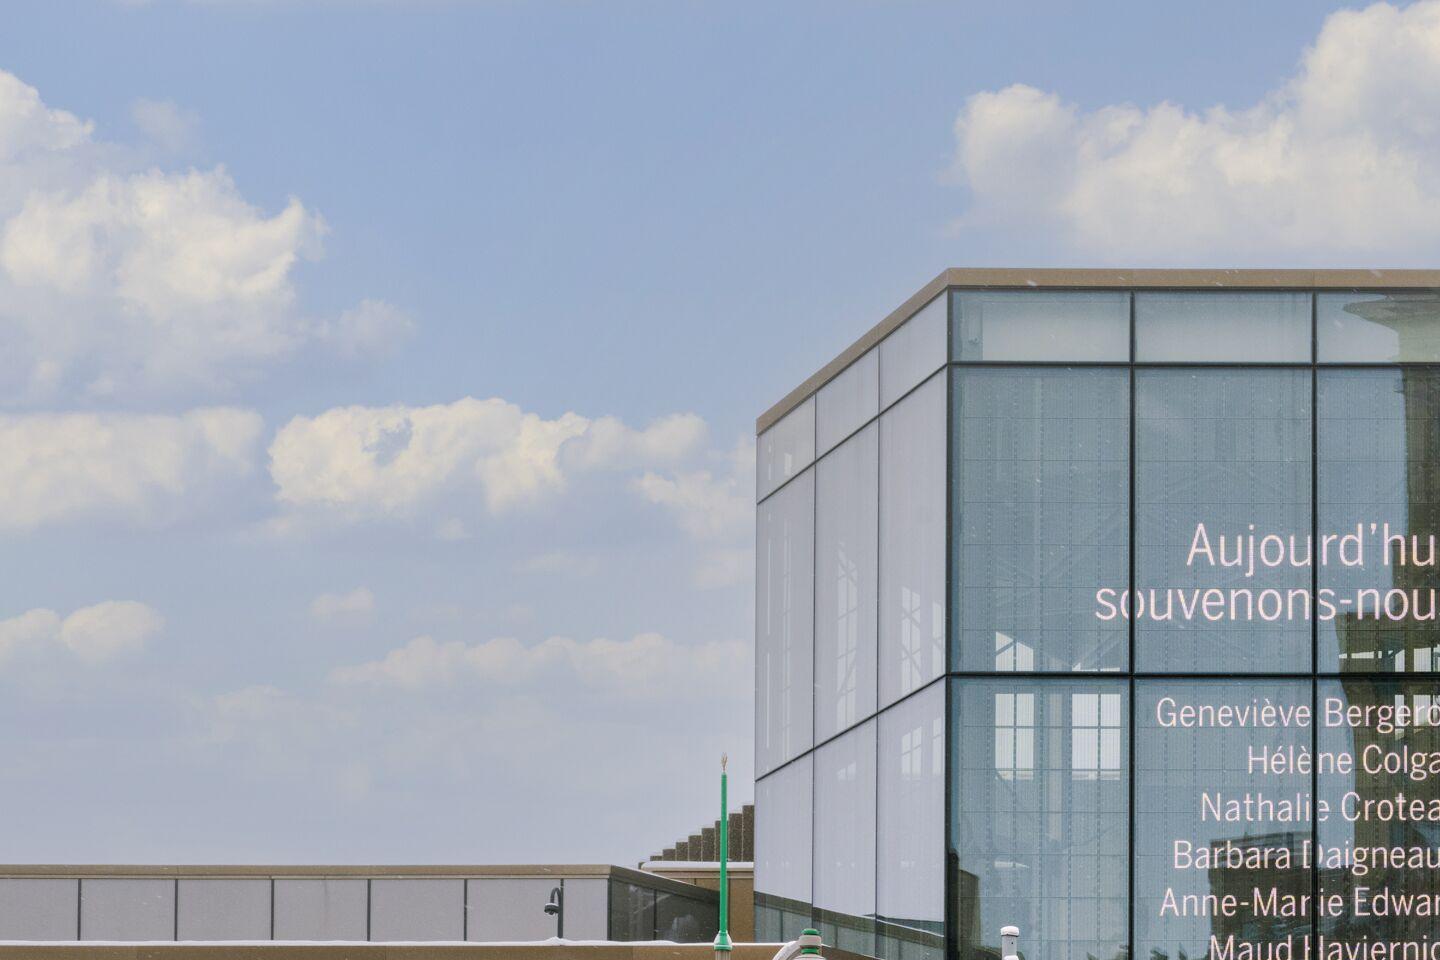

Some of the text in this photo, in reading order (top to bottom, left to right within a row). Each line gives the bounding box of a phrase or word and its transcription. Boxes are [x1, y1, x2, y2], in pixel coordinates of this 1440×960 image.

[1156, 697, 1311, 727] Geneviève
[1248, 744, 1353, 775] Hélène
[1201, 792, 1330, 822] Nathalie
[1173, 840, 1291, 870] Barbara
[1159, 887, 1344, 917] Anne-Marie
